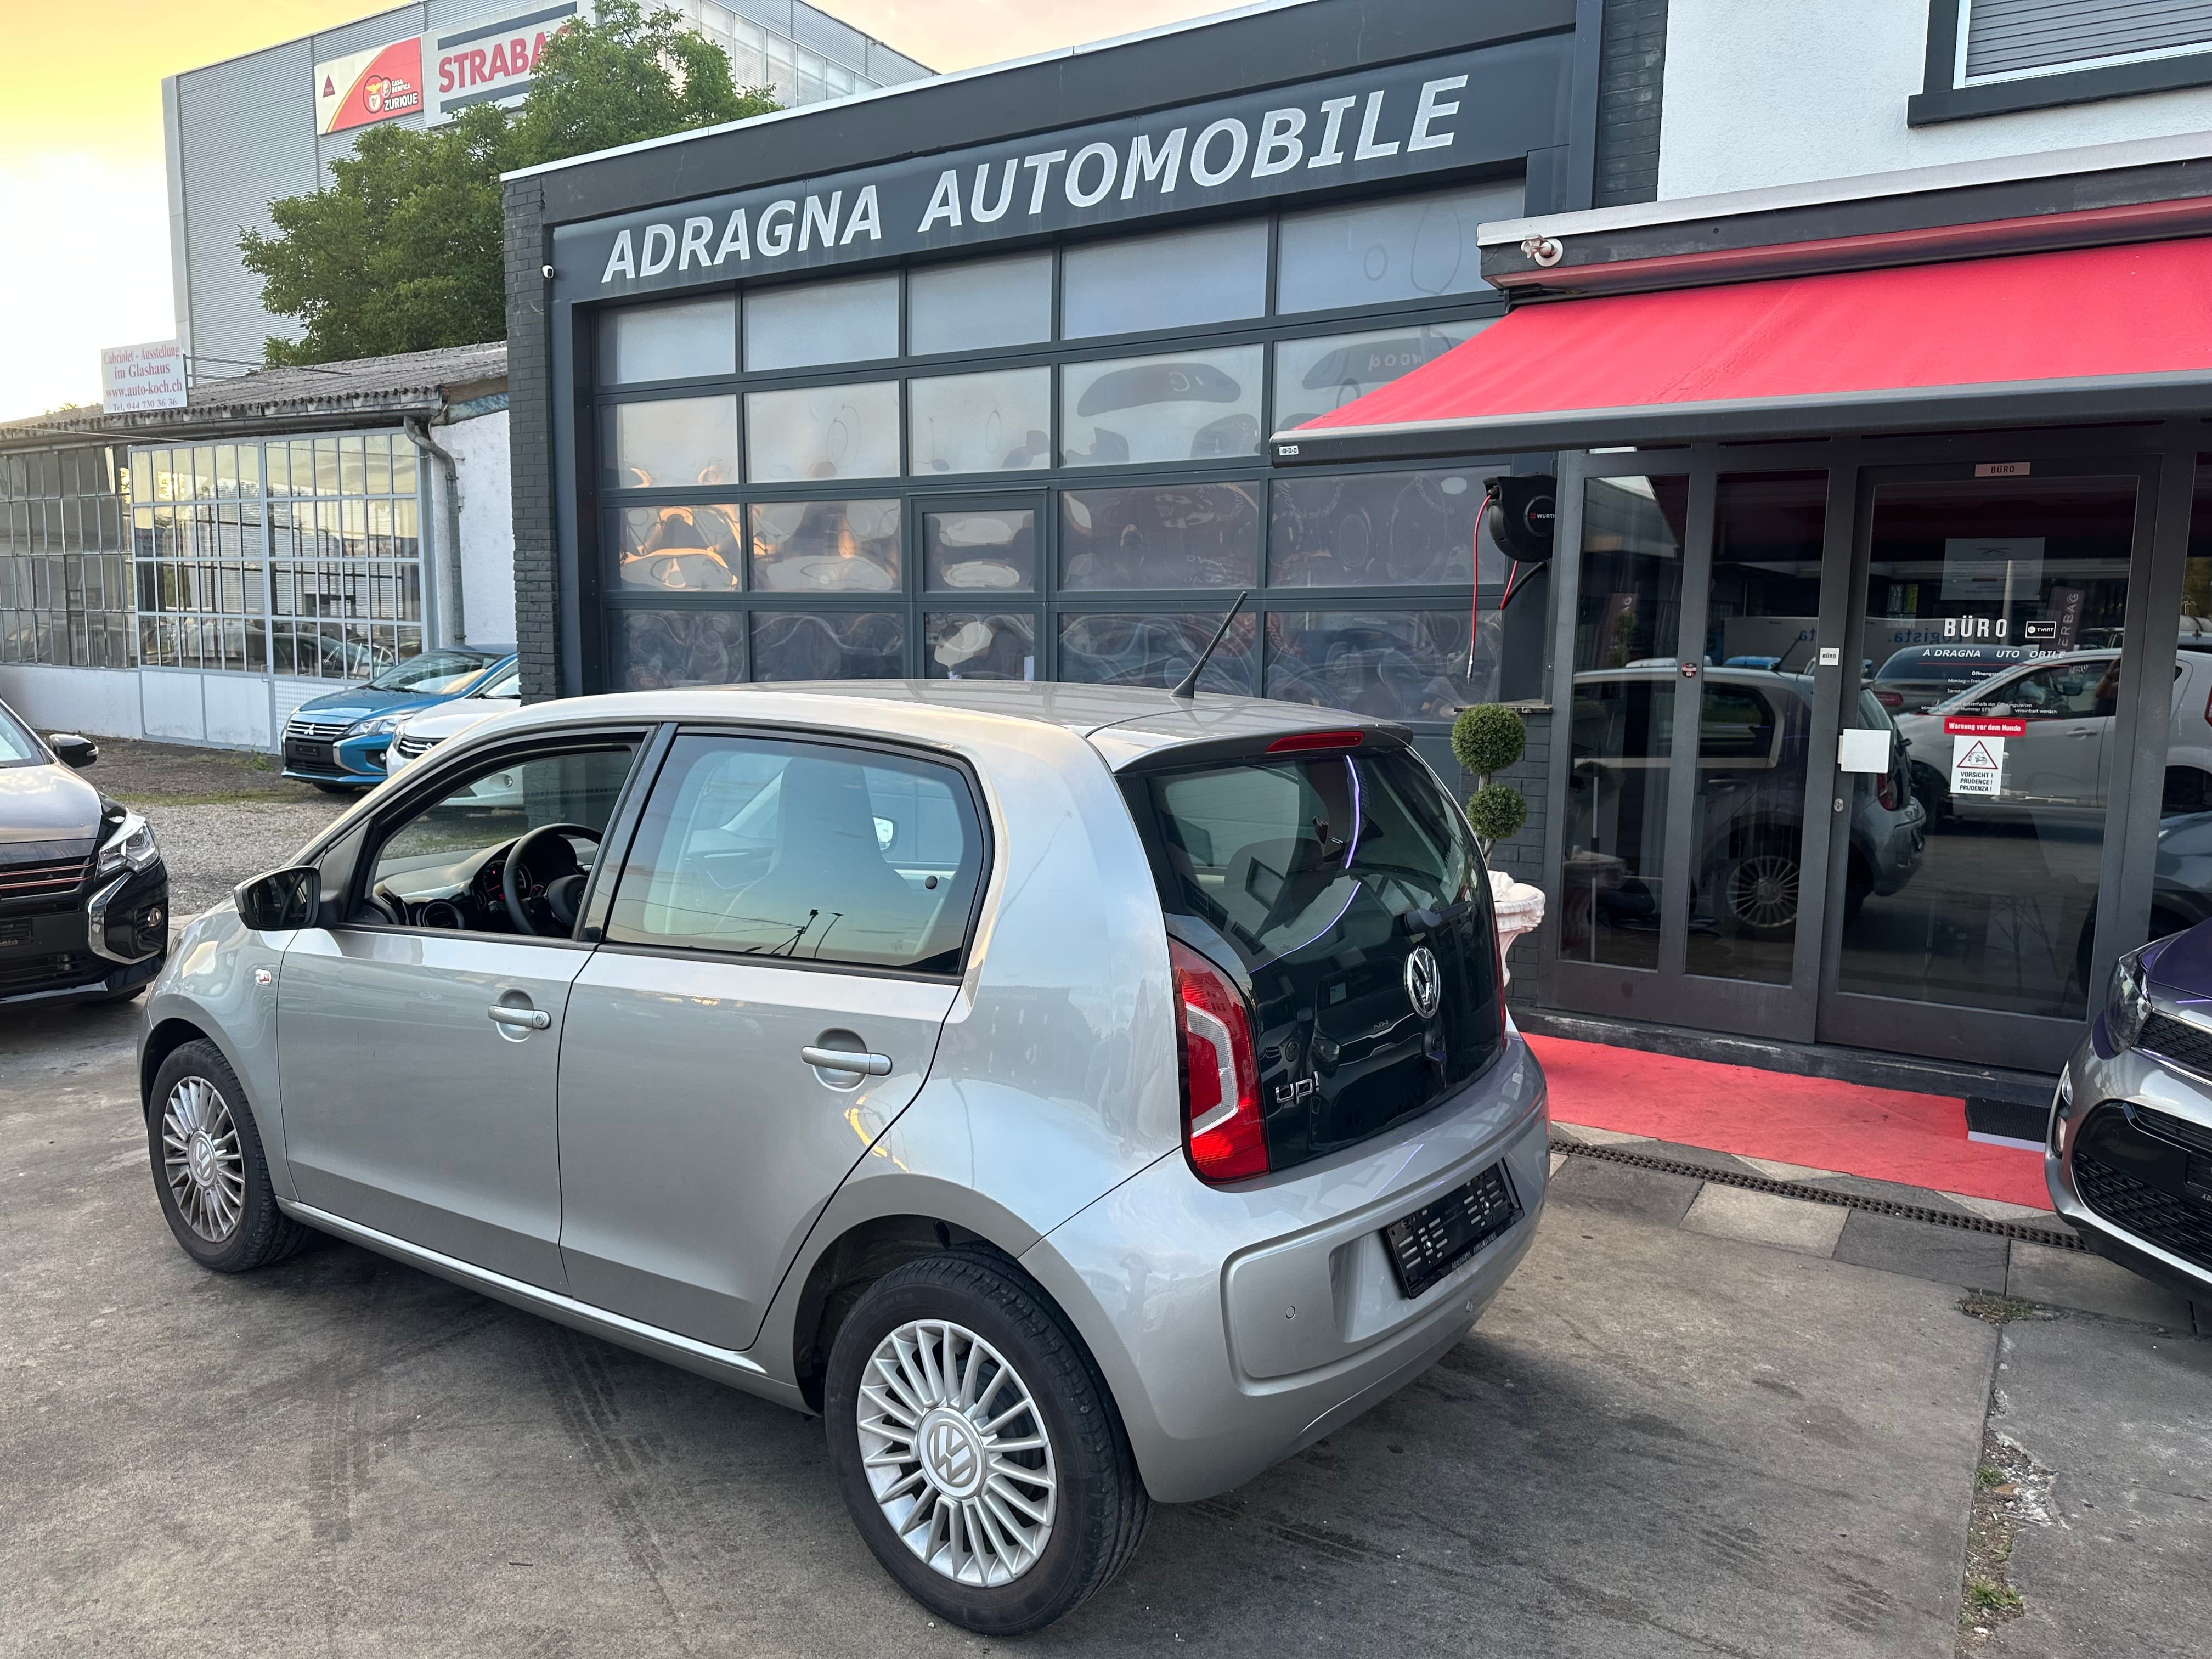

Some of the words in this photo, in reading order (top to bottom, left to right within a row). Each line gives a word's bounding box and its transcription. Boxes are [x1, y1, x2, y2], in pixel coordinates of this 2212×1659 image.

[439, 25, 571, 93] STRABA
[385, 93, 418, 111] ZURIQUE
[601, 184, 882, 283] ADRAGNA
[917, 74, 1469, 232] AUTOMOBILE
[104, 349, 133, 364] Cabriolet
[140, 344, 179, 359] Ausstellung
[115, 367, 125, 379] im
[128, 363, 170, 377] Glashaus
[106, 379, 182, 398] www.auto-koch.ch
[127, 402, 140, 410] 044
[142, 400, 155, 409] 730
[1991, 465, 2015, 473] BÜRO
[1944, 615, 2007, 637] BÜRO
[1949, 723, 1975, 731] Warnung
[1276, 1070, 1319, 1104] up!
